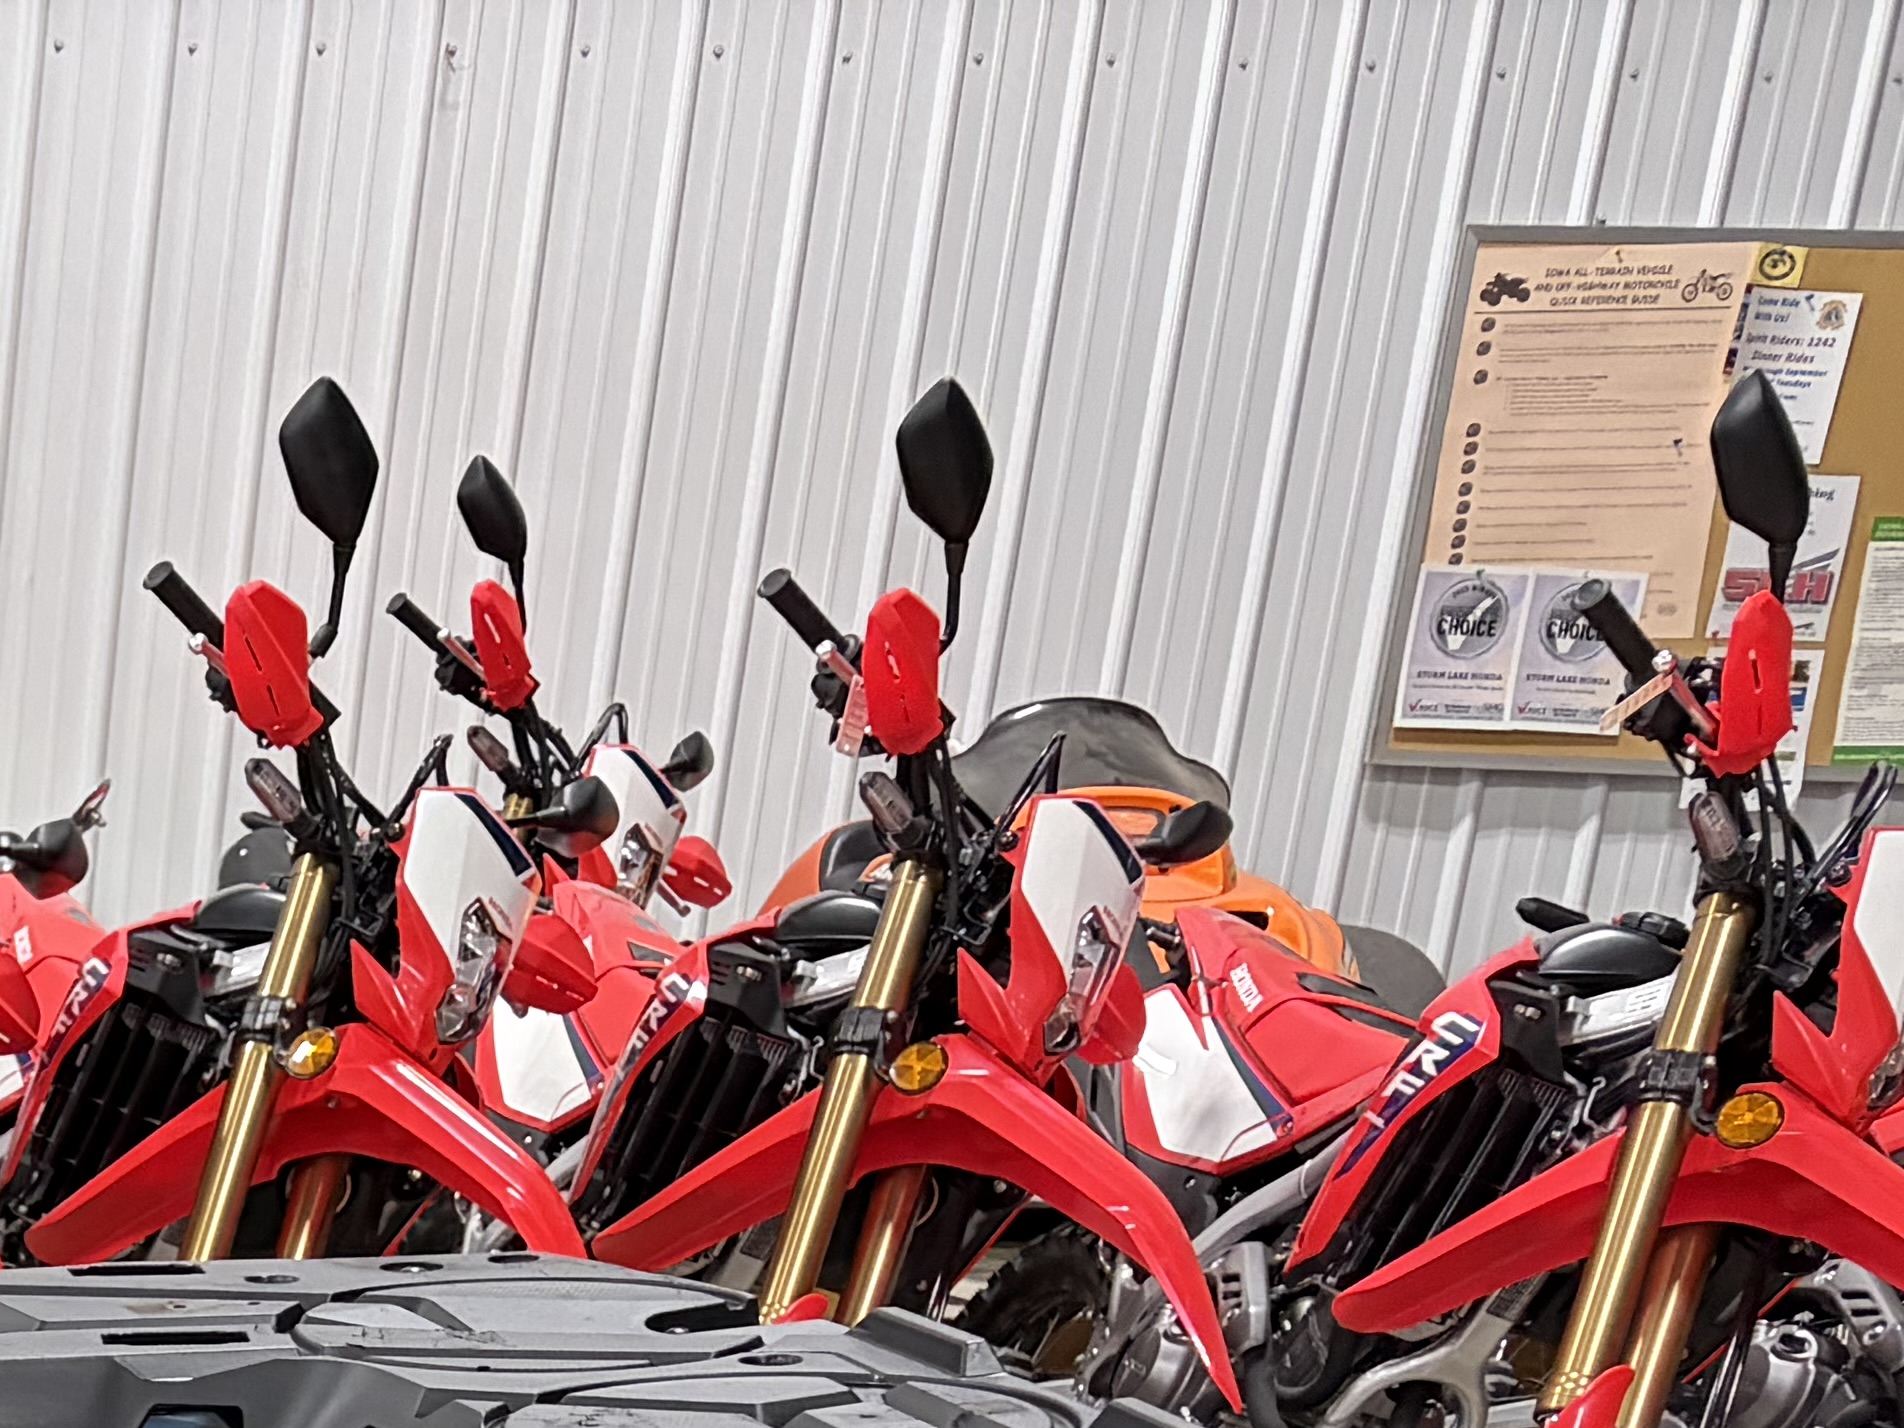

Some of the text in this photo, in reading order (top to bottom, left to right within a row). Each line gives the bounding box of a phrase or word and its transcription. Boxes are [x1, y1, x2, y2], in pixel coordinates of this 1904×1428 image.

[1807, 336, 1837, 348] 1242
[1437, 614, 1497, 638] CHOICE
[1230, 962, 1265, 1013] HONDA
